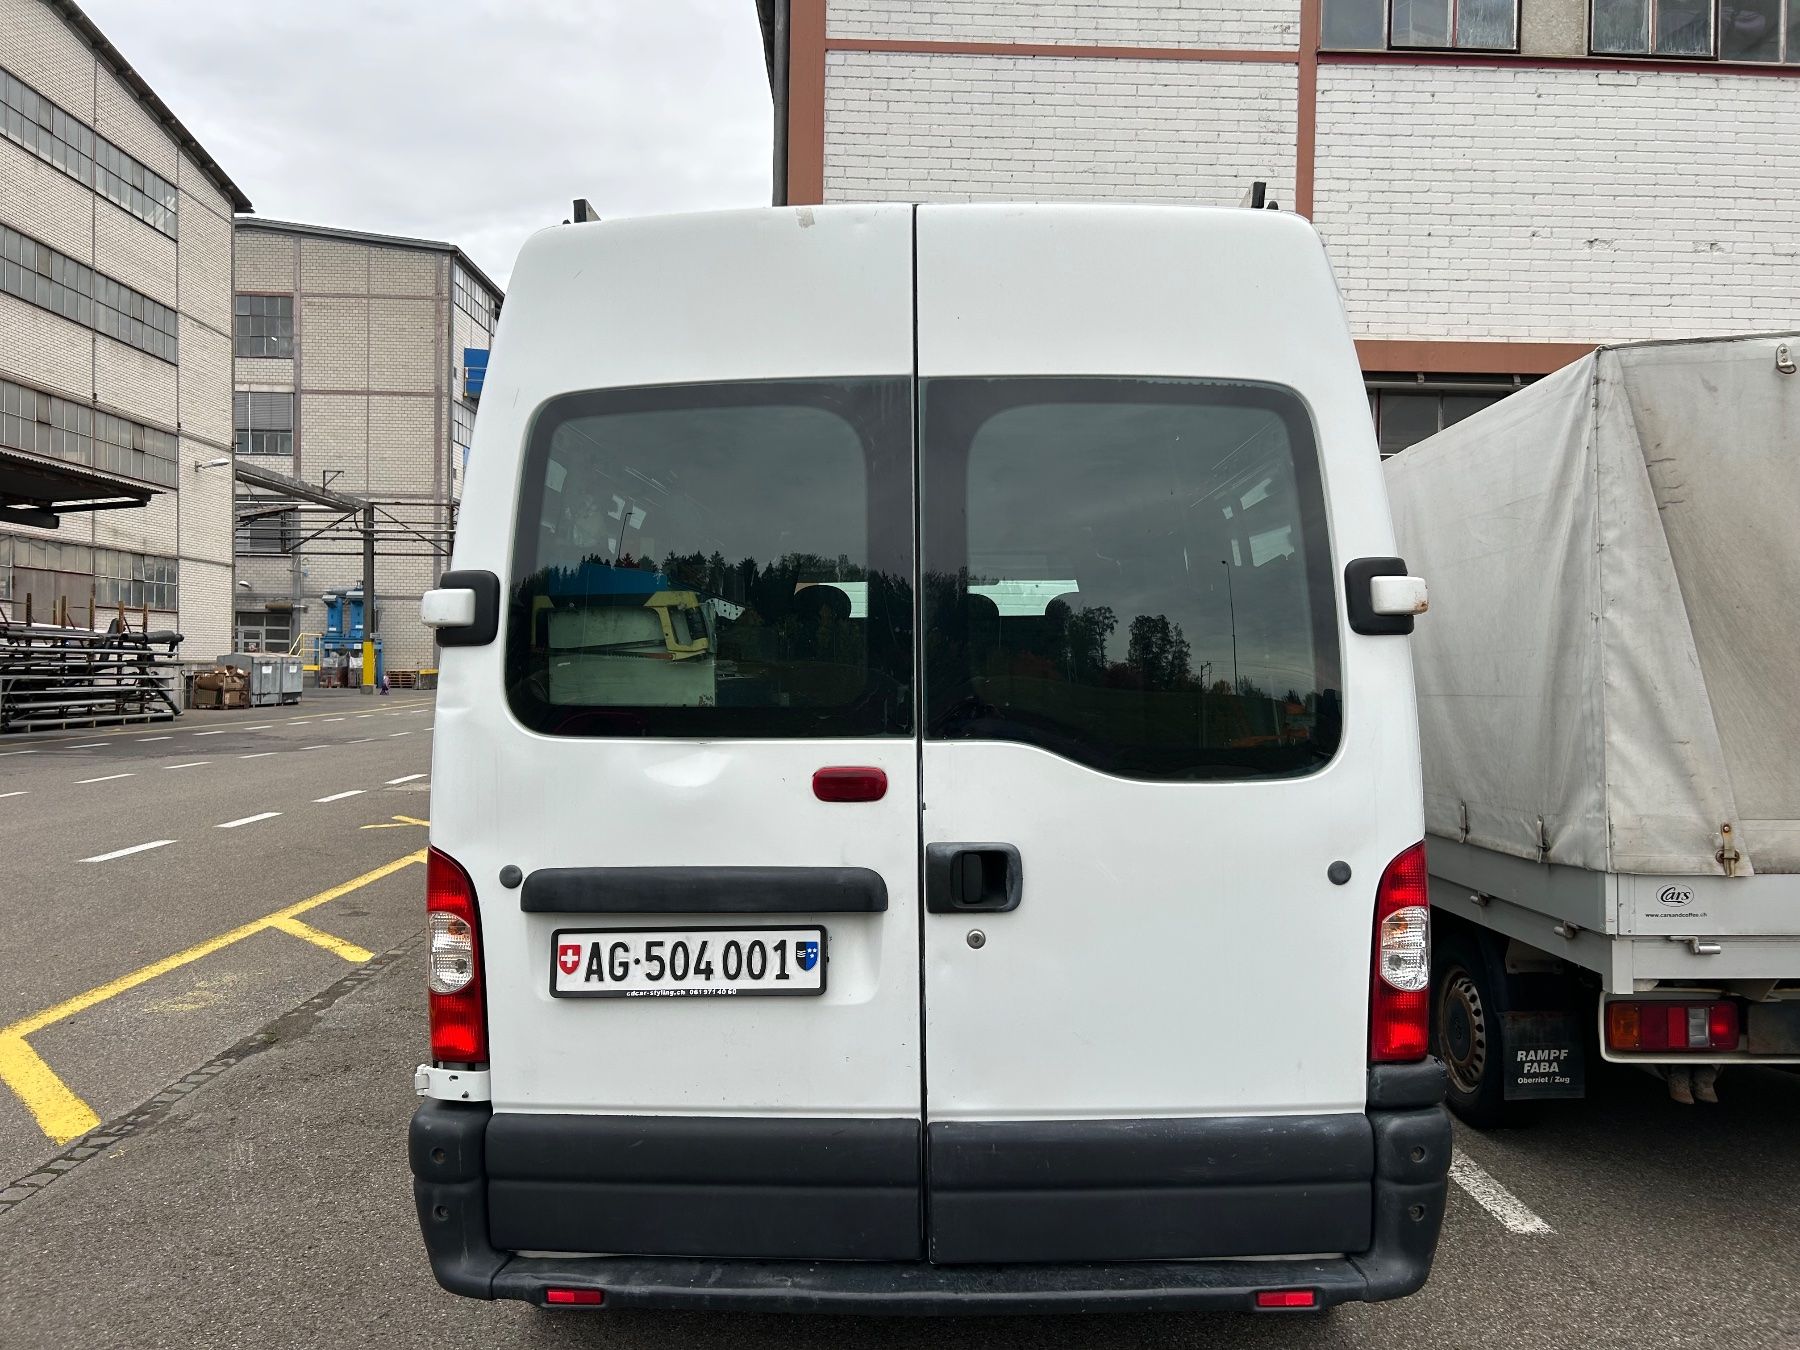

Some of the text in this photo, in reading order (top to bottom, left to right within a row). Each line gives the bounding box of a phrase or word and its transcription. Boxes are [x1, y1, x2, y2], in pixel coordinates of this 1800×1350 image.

[1660, 886, 1691, 905] Cars
[1516, 1049, 1569, 1062] RAMPF
[1523, 1062, 1560, 1074] FABA
[1517, 1076, 1549, 1084] Oberriet
[1554, 1076, 1570, 1084] Zug
